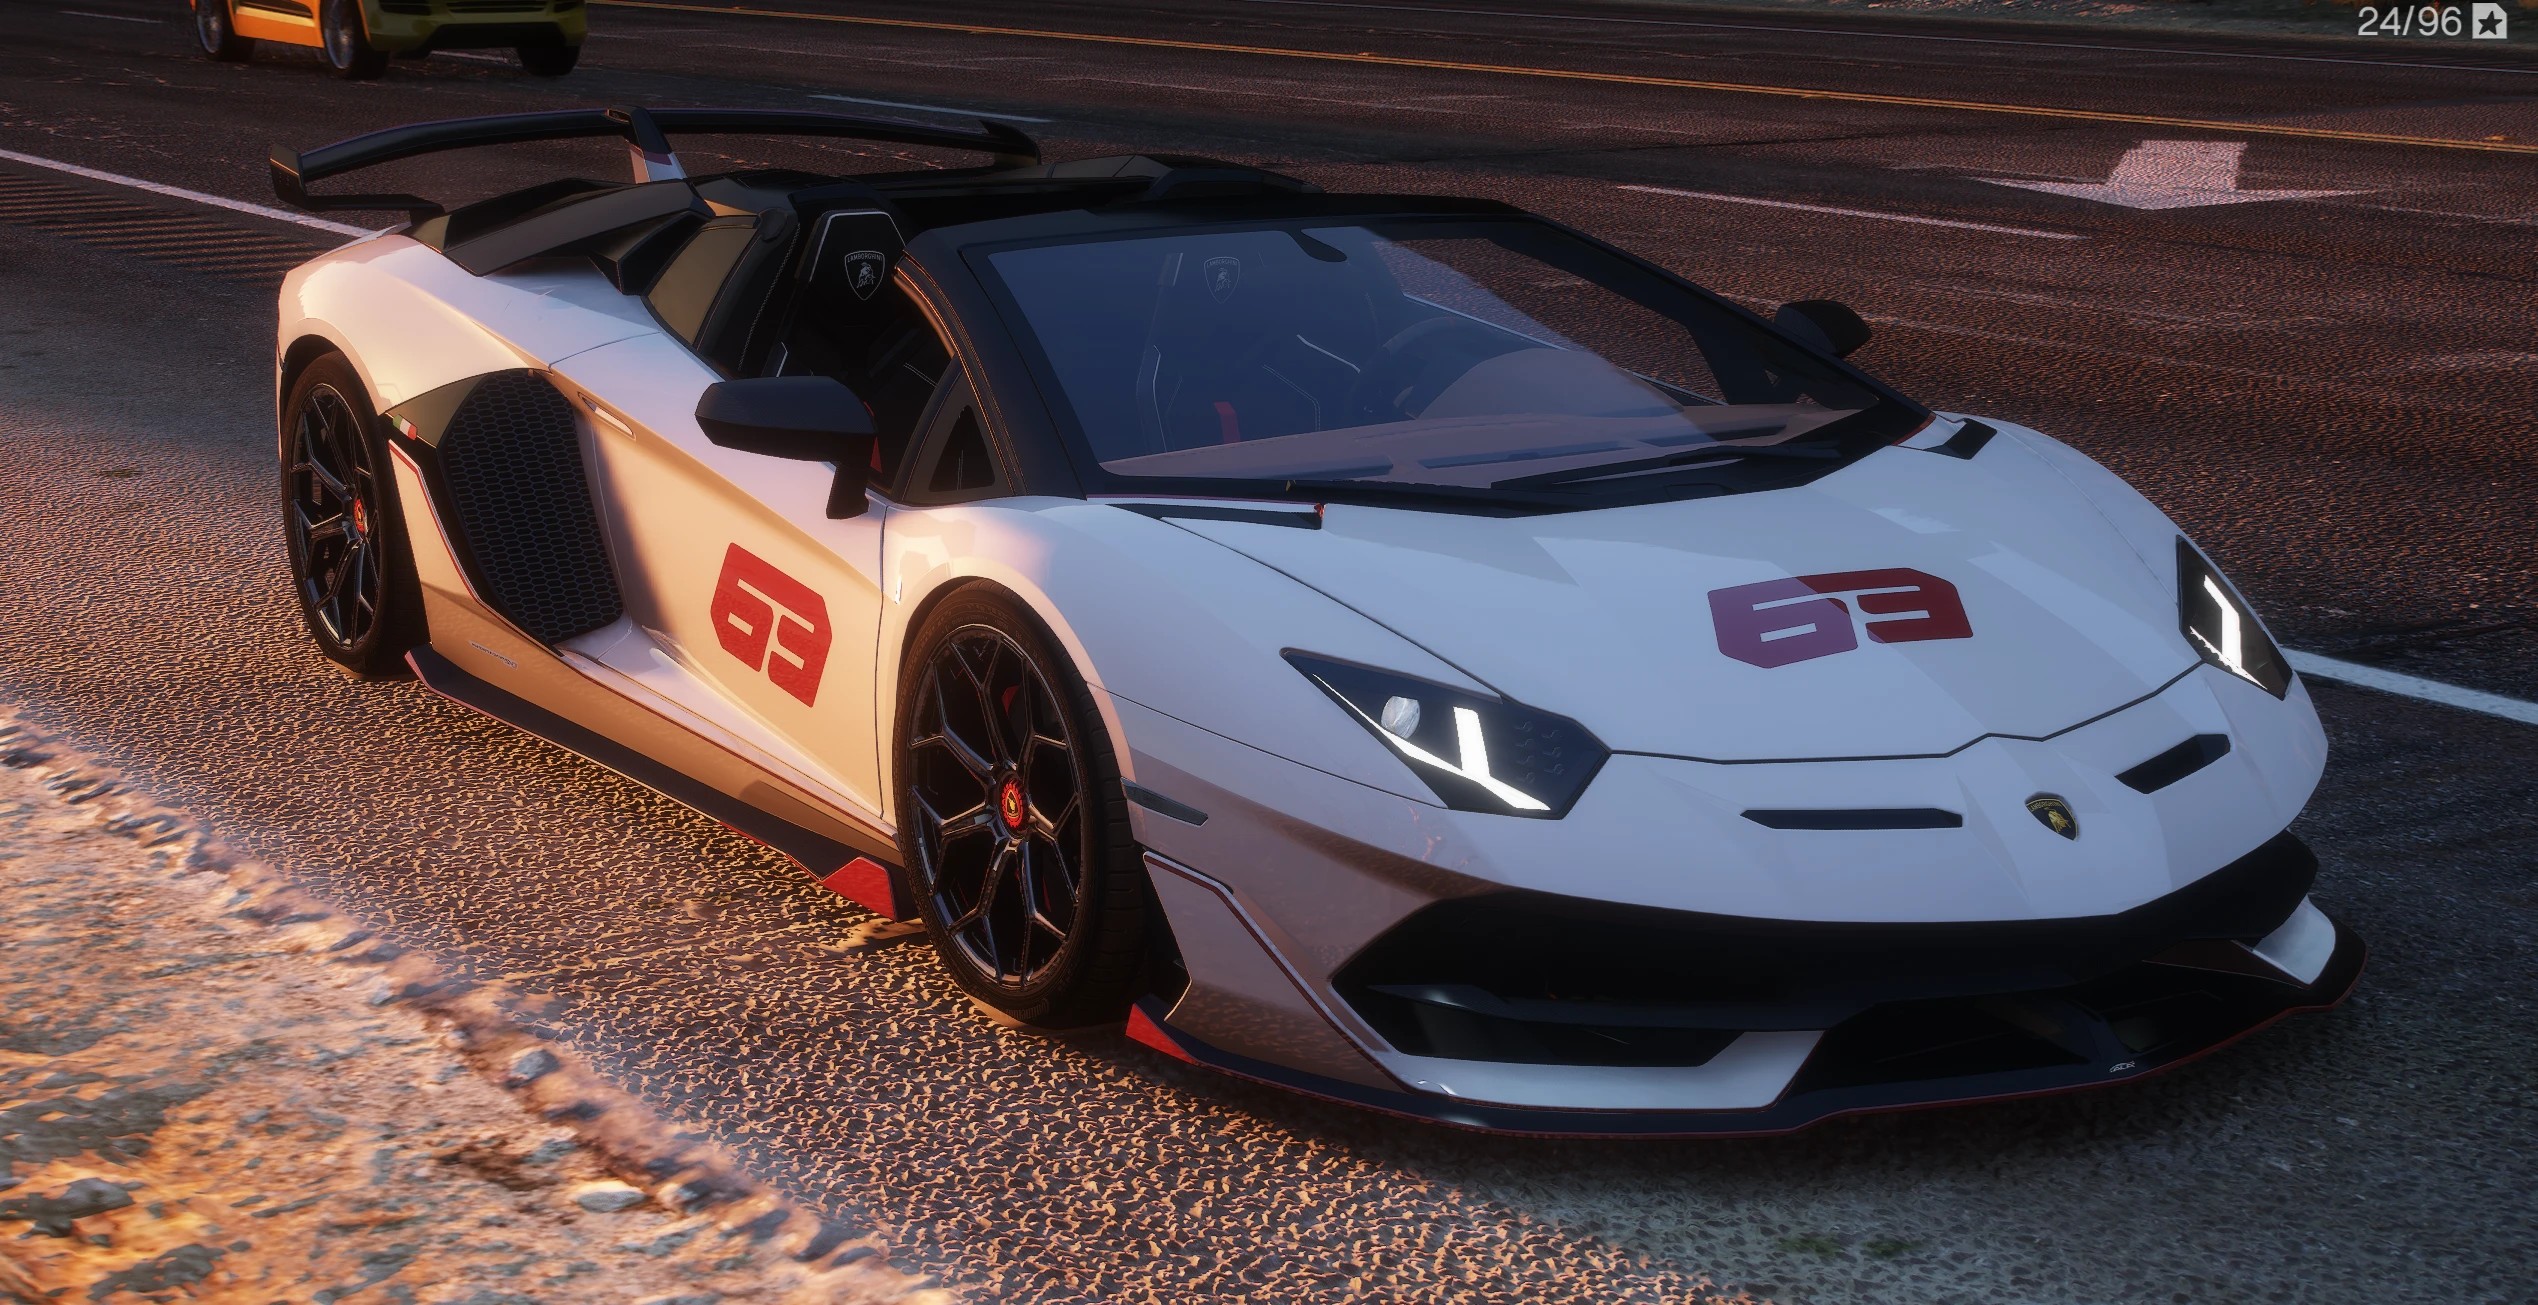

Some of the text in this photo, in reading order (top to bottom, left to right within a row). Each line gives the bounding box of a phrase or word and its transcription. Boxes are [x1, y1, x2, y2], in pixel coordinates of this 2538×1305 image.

[847, 252, 883, 263] LAMBORGHINI
[710, 542, 832, 708] 63
[1707, 567, 1974, 669] 63
